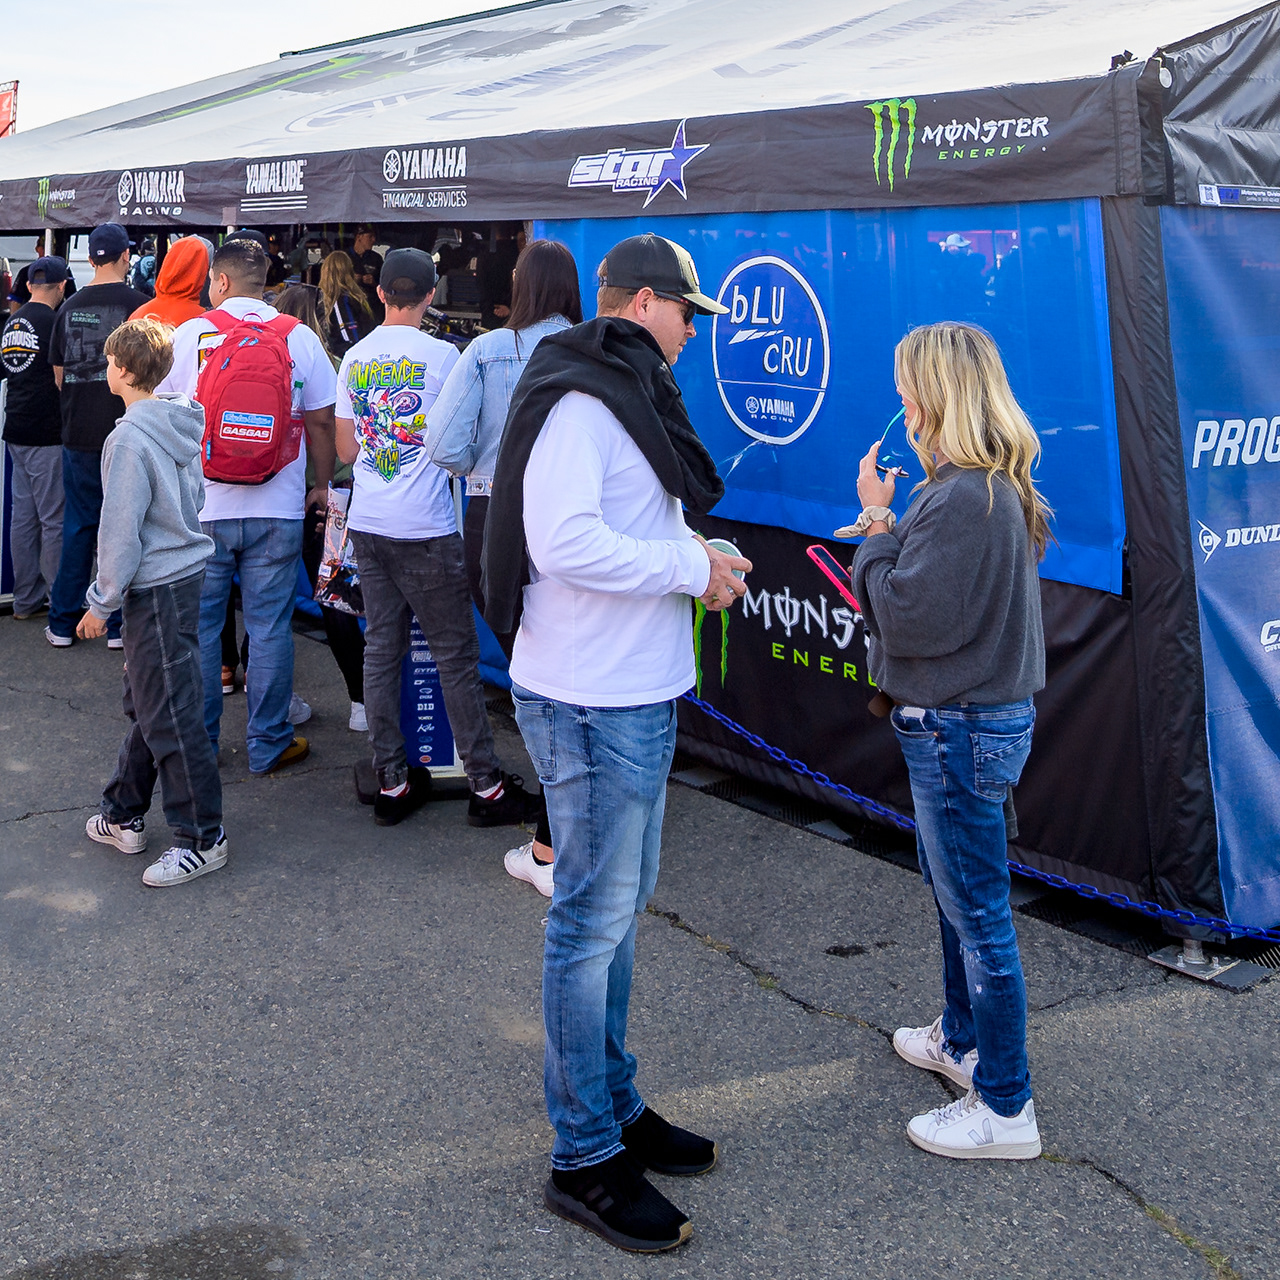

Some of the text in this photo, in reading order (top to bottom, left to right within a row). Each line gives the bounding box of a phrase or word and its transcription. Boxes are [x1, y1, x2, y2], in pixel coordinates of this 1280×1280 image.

[921, 114, 1050, 146] MONSTER
[402, 146, 467, 181] YAMAHA
[572, 148, 674, 184] star
[937, 145, 1026, 161] ENERGY
[133, 170, 186, 204] YAMAHA
[245, 160, 305, 195] YAMALUBE
[615, 175, 659, 188] RACING
[119, 206, 184, 217] RACING
[382, 190, 468, 208] FINANCIAL SERVICES
[729, 284, 786, 326] bLU
[1, 330, 40, 350] STHOUSE
[762, 334, 814, 379] cRU
[347, 357, 427, 390] LAWRENCE
[750, 414, 794, 424] RACING
[759, 398, 796, 417] YAMAHA
[222, 426, 270, 439] GASGAS
[741, 585, 864, 650] MONS
[771, 642, 878, 687] ENER
